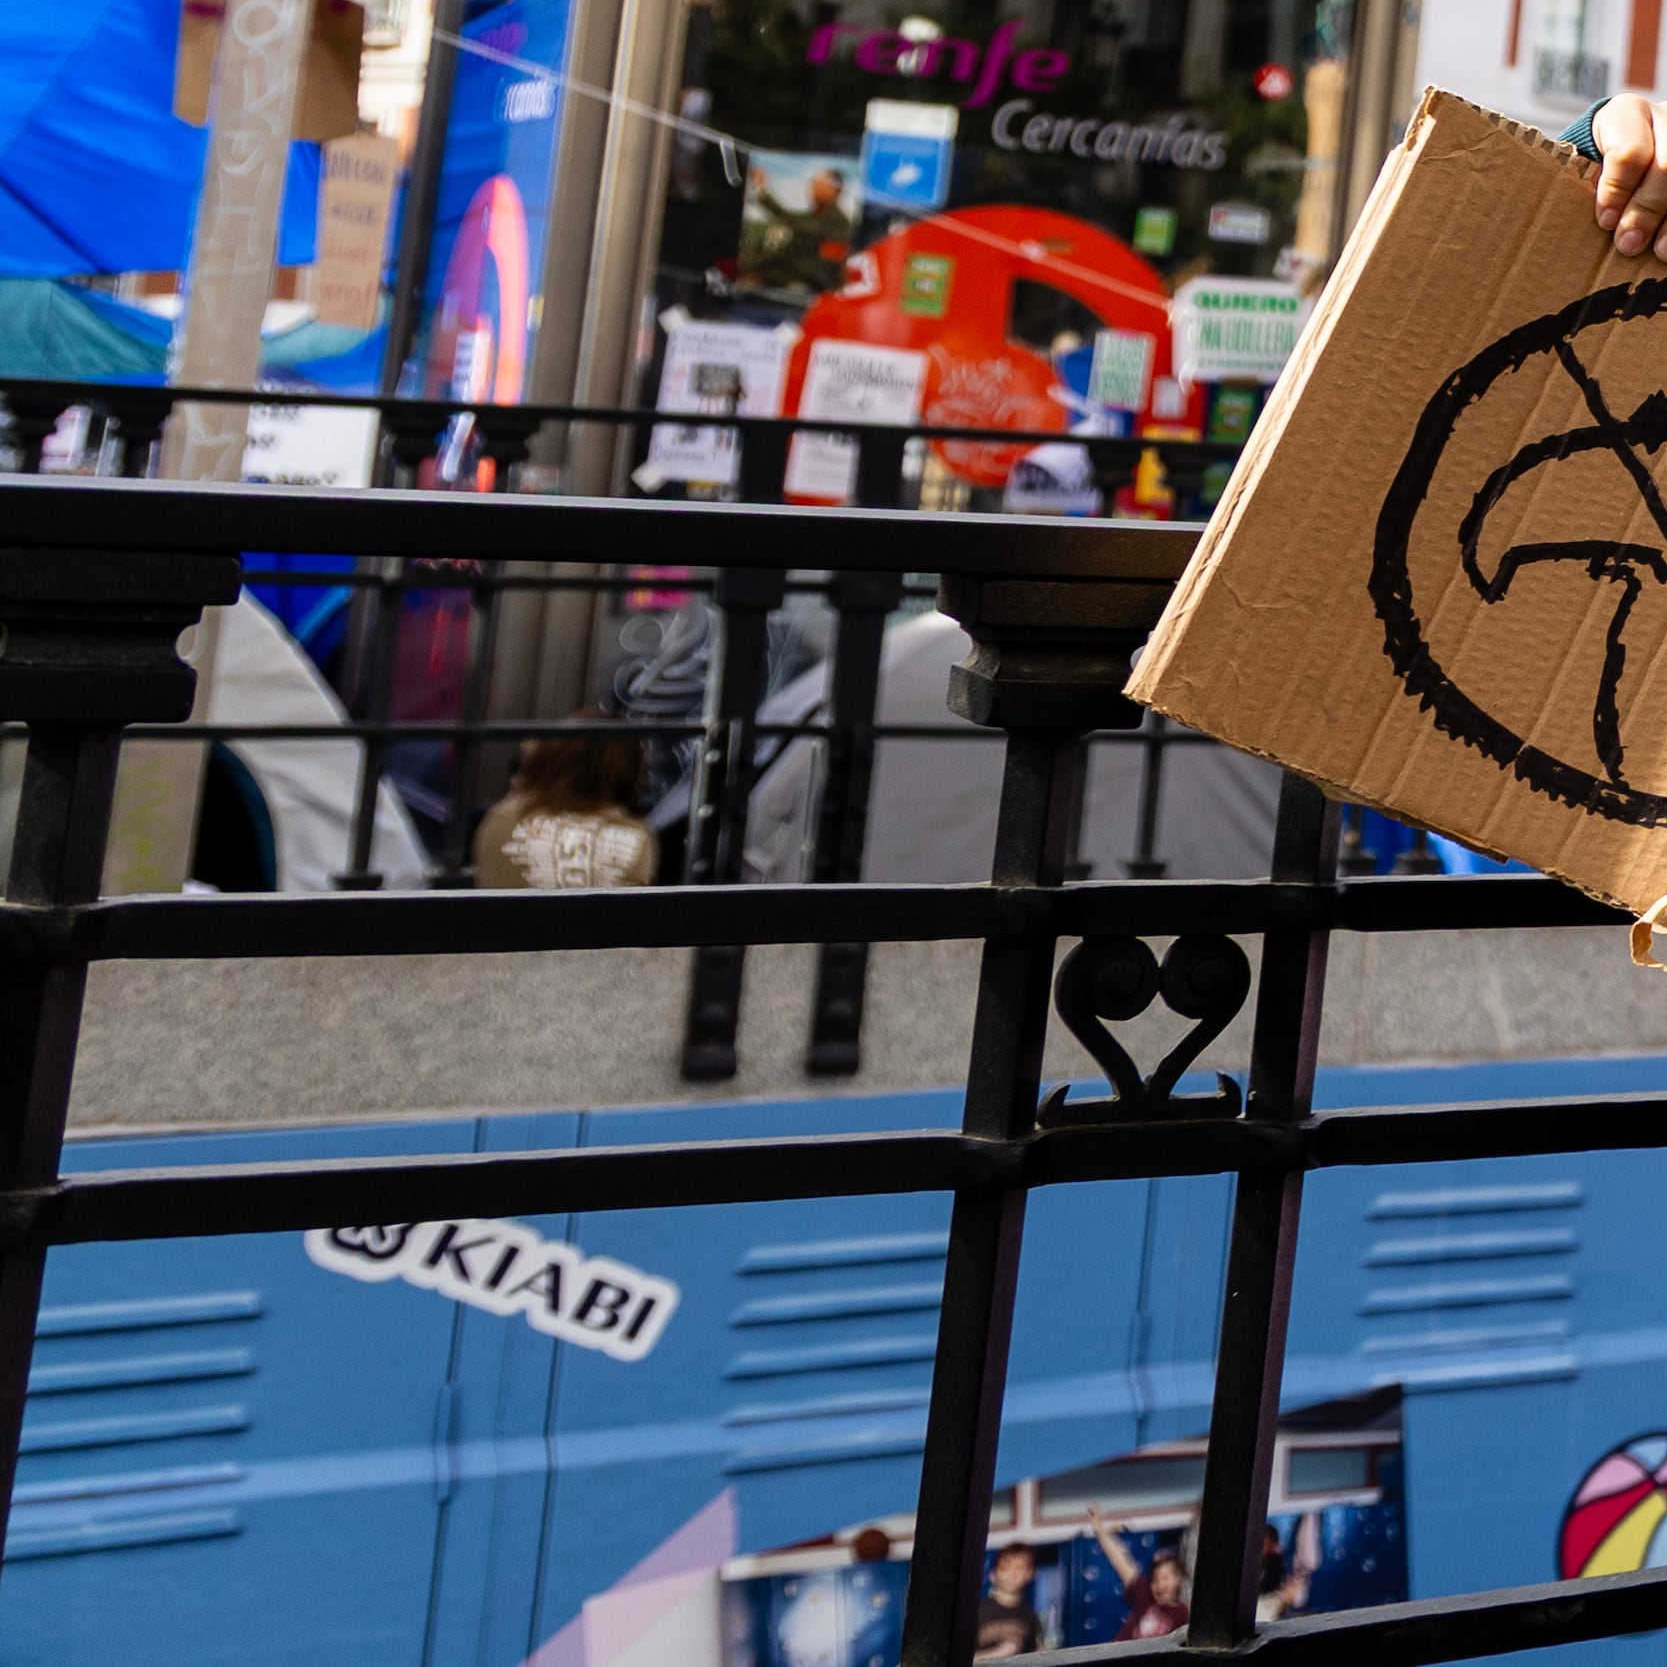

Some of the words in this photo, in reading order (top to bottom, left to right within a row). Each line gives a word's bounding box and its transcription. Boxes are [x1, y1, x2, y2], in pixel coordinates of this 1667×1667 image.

[806, 20, 1071, 111] renfe
[992, 98, 1229, 171] Cercanías
[422, 1223, 657, 1344] KIABI
